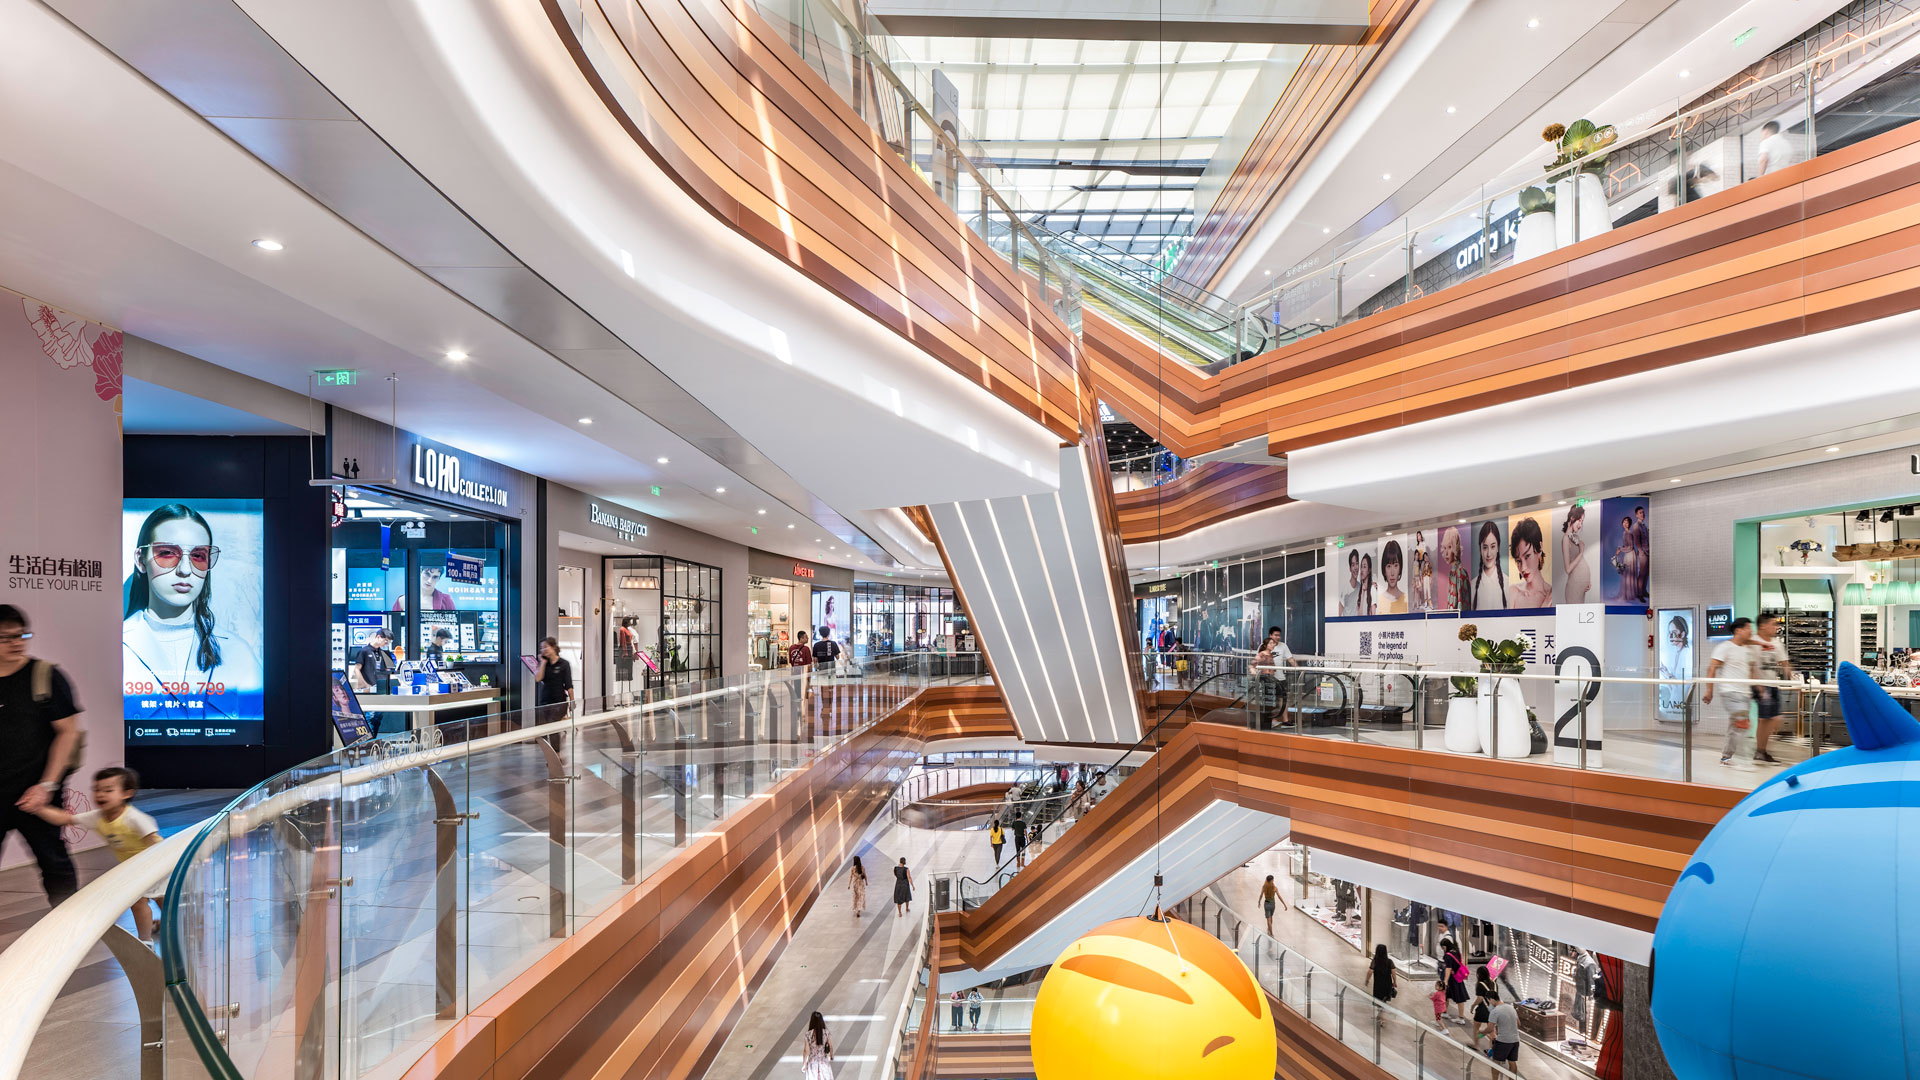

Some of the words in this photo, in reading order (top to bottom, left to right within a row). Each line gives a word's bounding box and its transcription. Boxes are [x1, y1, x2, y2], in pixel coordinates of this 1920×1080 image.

[1456, 230, 1499, 270] anta
[415, 443, 460, 495] LOHO
[460, 478, 508, 508] COLLECTION
[9, 555, 102, 578] 生活自有格调
[9, 577, 44, 589] STYLE
[47, 578, 78, 591] YOUR
[81, 580, 102, 592] LIFE
[1578, 612, 1595, 624] L2
[1378, 631, 1405, 640] 小照片的传奇
[1378, 641, 1386, 650] the
[1386, 641, 1402, 651] legend
[1402, 641, 1408, 650] of
[1386, 651, 1404, 661] photos
[125, 681, 154, 696] 399
[161, 681, 190, 696] 599
[196, 681, 225, 696] 799
[1554, 645, 1602, 751] 2
